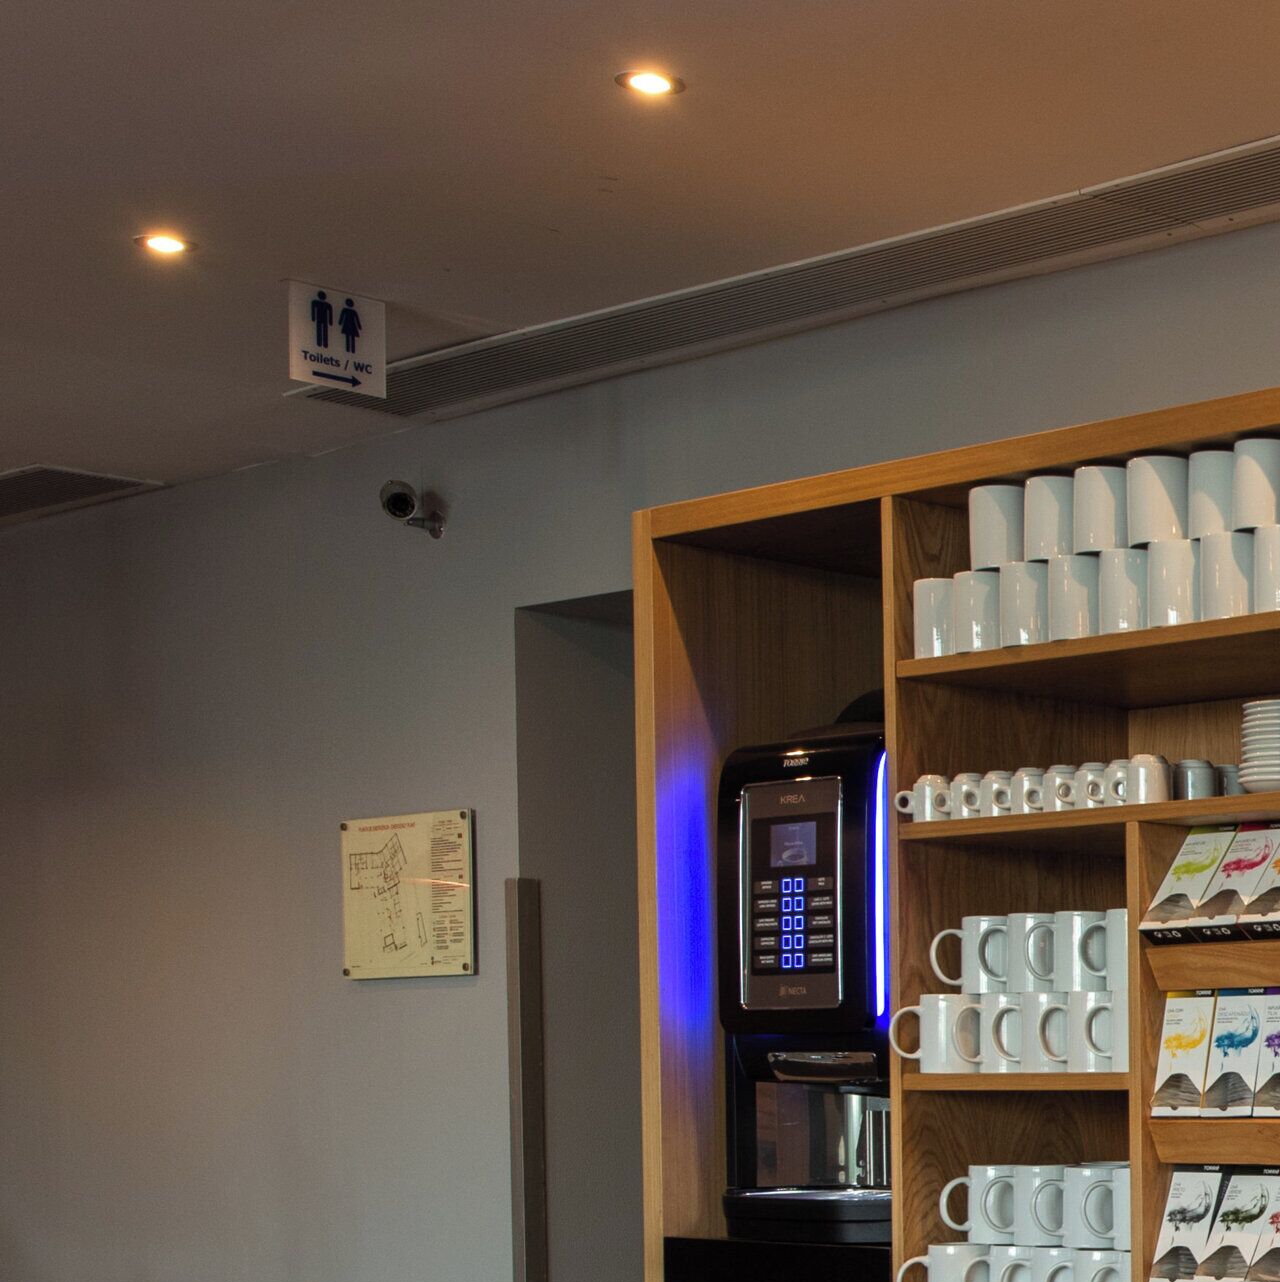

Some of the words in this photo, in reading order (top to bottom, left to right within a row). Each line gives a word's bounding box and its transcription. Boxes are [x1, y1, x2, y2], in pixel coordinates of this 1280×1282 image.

[302, 350, 340, 367] Toilets
[344, 360, 349, 371] /
[353, 361, 373, 374] WC
[780, 794, 805, 804] KREA
